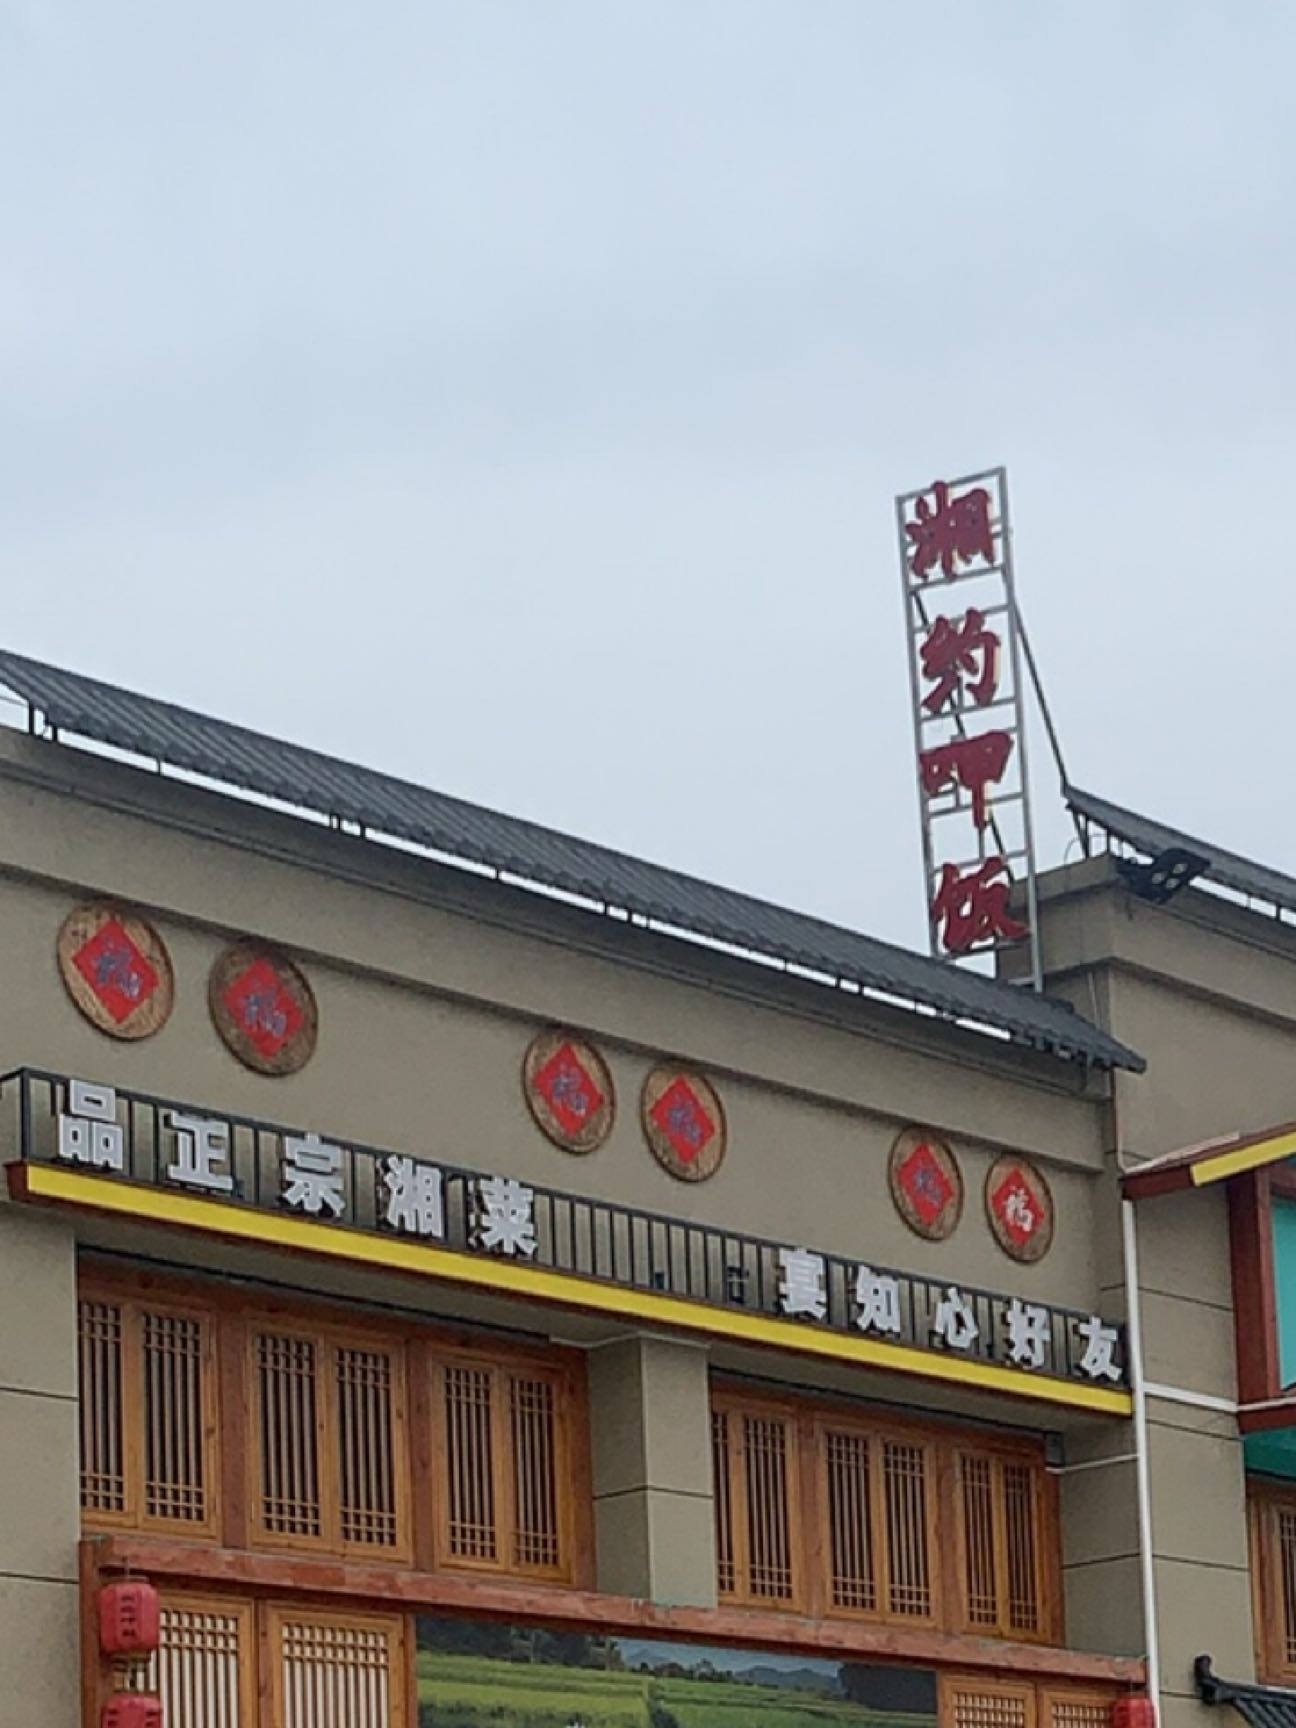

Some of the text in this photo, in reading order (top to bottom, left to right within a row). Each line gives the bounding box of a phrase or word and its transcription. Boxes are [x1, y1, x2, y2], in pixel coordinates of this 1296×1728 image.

[58, 1078, 538, 1257] 品正宗湘菜
